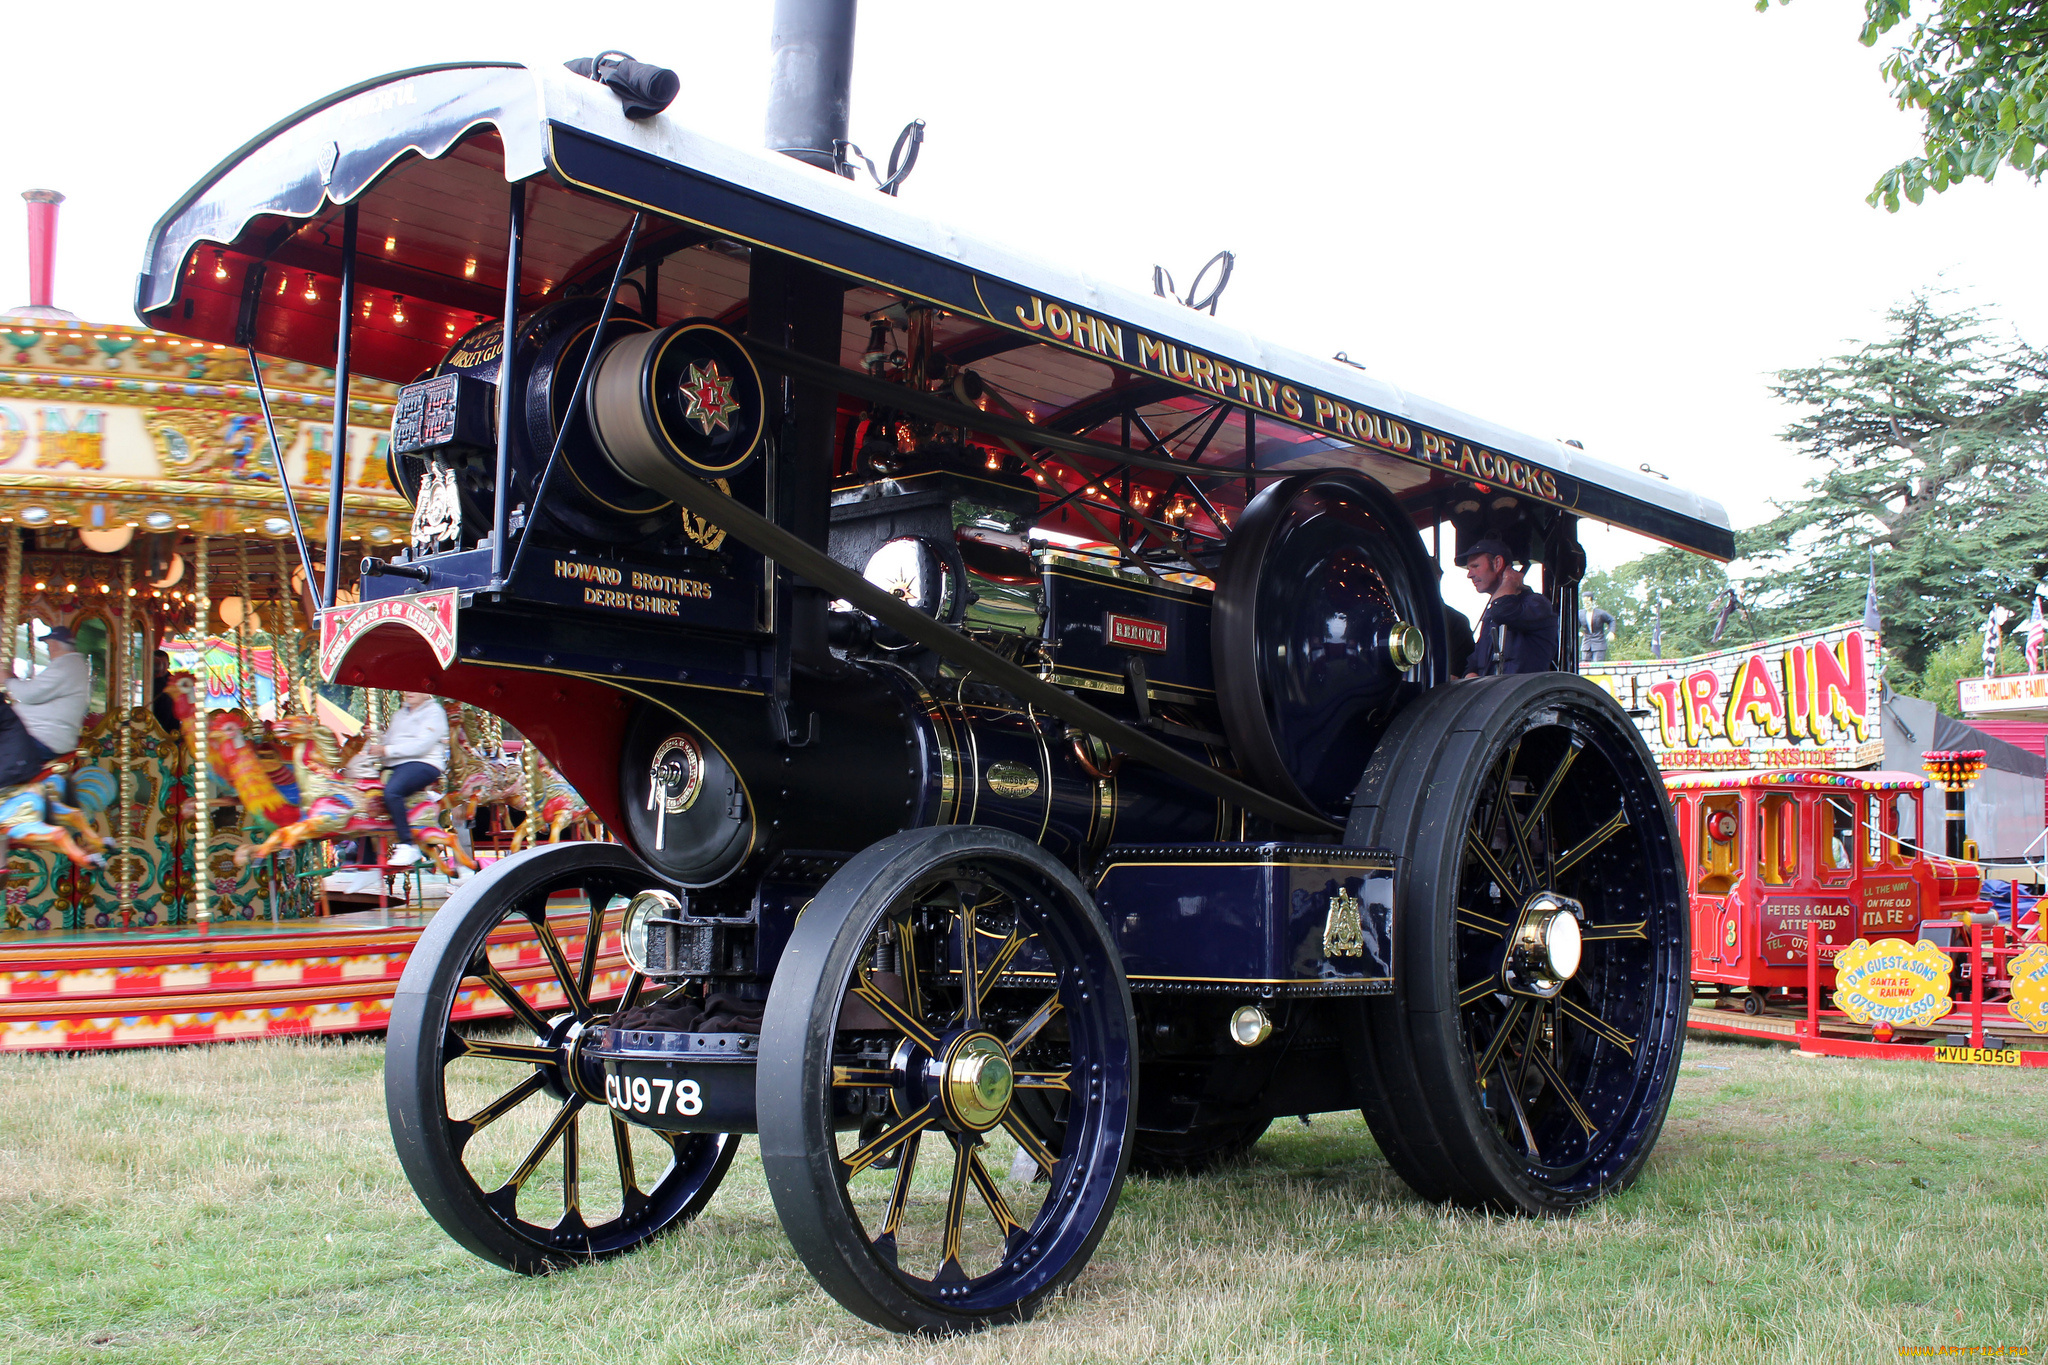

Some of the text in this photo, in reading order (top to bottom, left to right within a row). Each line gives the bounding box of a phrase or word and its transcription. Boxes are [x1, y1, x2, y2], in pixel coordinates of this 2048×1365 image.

[1015, 295, 1124, 362] JOHN
[1137, 333, 1303, 420] MURPHYS
[1313, 394, 1412, 453] PROUD
[554, 559, 712, 600] HOWARD BROTHERS
[584, 587, 680, 616] DERBYSHIRE
[1648, 631, 1870, 748] TRAIN
[1965, 683, 1977, 693] THE
[1982, 681, 2021, 701] THRILLING
[1964, 695, 1980, 706] MOST
[1662, 749, 1750, 766] HORRORS
[1767, 749, 1837, 766] INSIDE
[1876, 885, 1890, 895] THE
[1892, 882, 1909, 892] WAY
[1767, 904, 1850, 917] FETES & GALAS
[1867, 898, 1911, 908] ON THE OLD
[1779, 919, 1836, 930] ATTEDED
[1887, 909, 1904, 924] FE
[1725, 919, 1737, 947] 3
[1909, 960, 1938, 981] SONS
[1869, 977, 1910, 987] SANTA FE
[1879, 988, 1916, 998] RAILWAY
[1938, 1047, 2015, 1064] MVU 505G
[605, 1073, 703, 1117] CU978
